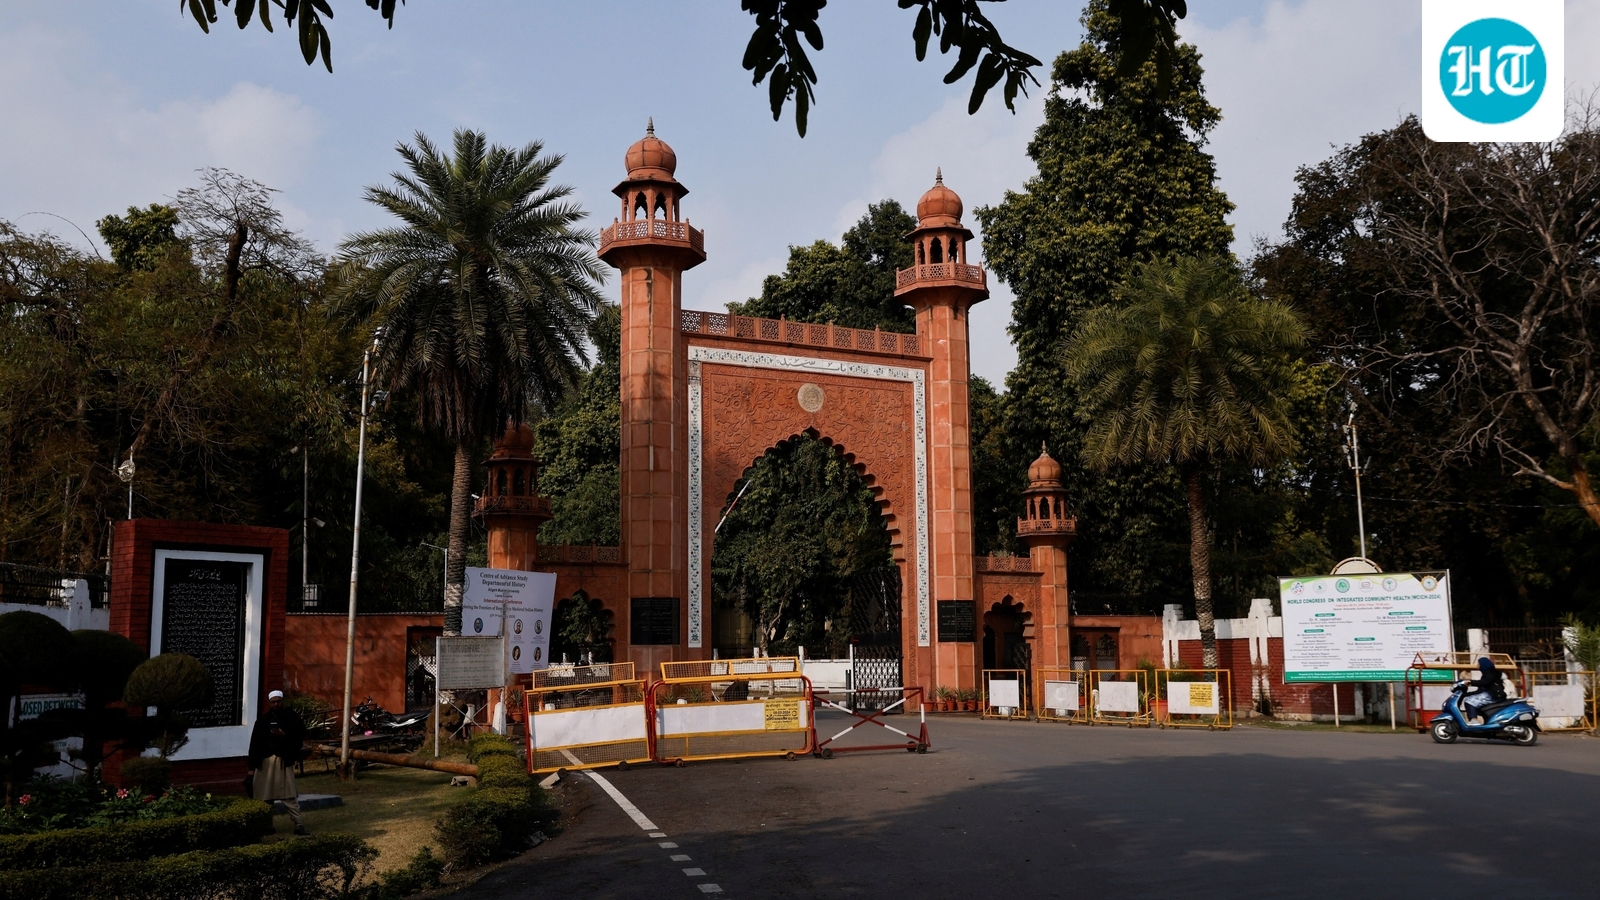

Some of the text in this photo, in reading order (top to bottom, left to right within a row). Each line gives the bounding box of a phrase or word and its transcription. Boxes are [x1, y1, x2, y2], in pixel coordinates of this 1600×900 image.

[482, 579, 505, 587] Department
[511, 581, 526, 589] History
[517, 575, 529, 583] Study
[19, 701, 42, 715] LOSED
